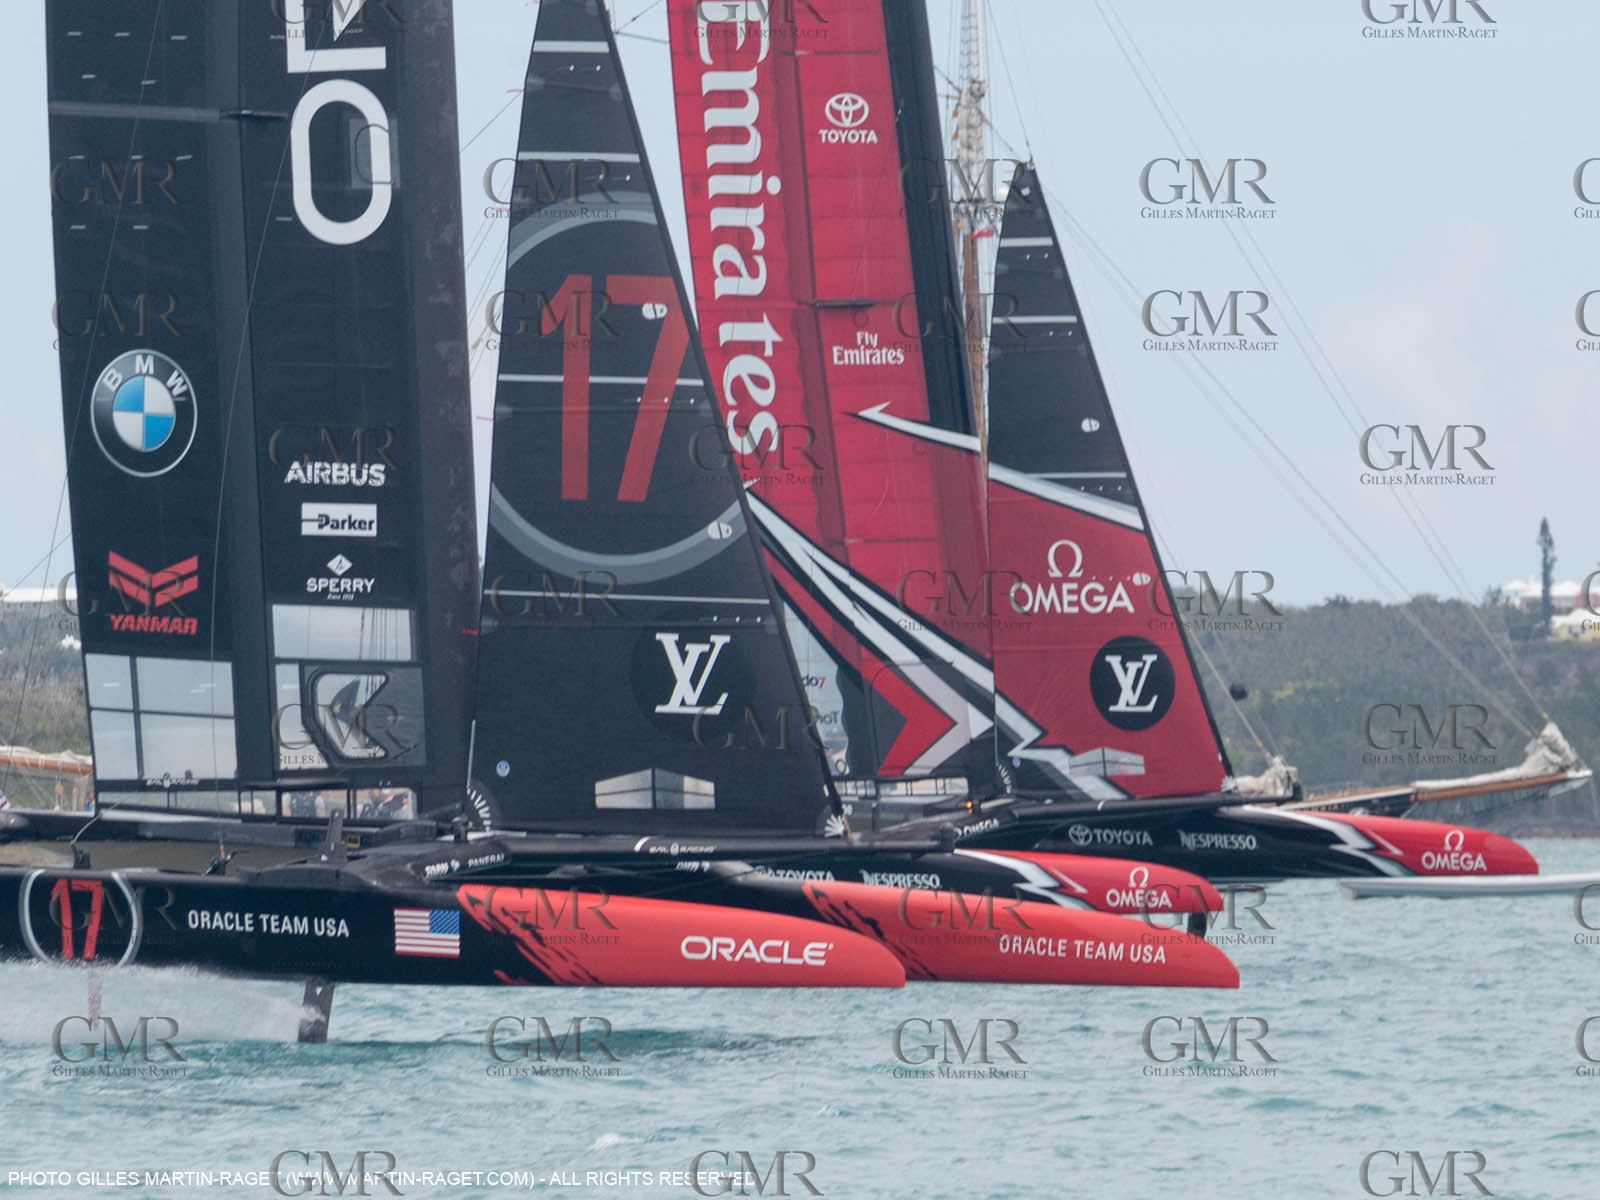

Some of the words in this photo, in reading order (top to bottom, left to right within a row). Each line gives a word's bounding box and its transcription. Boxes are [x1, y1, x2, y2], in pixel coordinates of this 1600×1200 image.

[819, 129, 878, 144] TOYOTA
[856, 331, 878, 348] Fly
[832, 345, 905, 365] Emirates
[103, 354, 188, 397] BMW
[541, 274, 690, 503] 17
[284, 460, 386, 487] AIRBUS
[317, 513, 375, 531] Parker
[306, 577, 375, 593] SPERRY
[1009, 581, 1135, 614] OMEGA
[109, 613, 198, 635] YANMAR
[1093, 829, 1153, 846] TOYOTA
[1178, 830, 1258, 850] NESPRESSO
[1421, 851, 1488, 872] OMEGA
[774, 869, 836, 881] TOYOTA
[859, 870, 941, 889] NESPRESSO
[1106, 888, 1173, 909] OMEGA
[50, 878, 103, 961] 17
[187, 909, 255, 933] ORACLE
[258, 913, 309, 936] TEAM
[313, 917, 350, 938] USA
[1000, 934, 1067, 959] ORACLE
[1074, 940, 1124, 962] TEAM
[1129, 944, 1167, 965] USA
